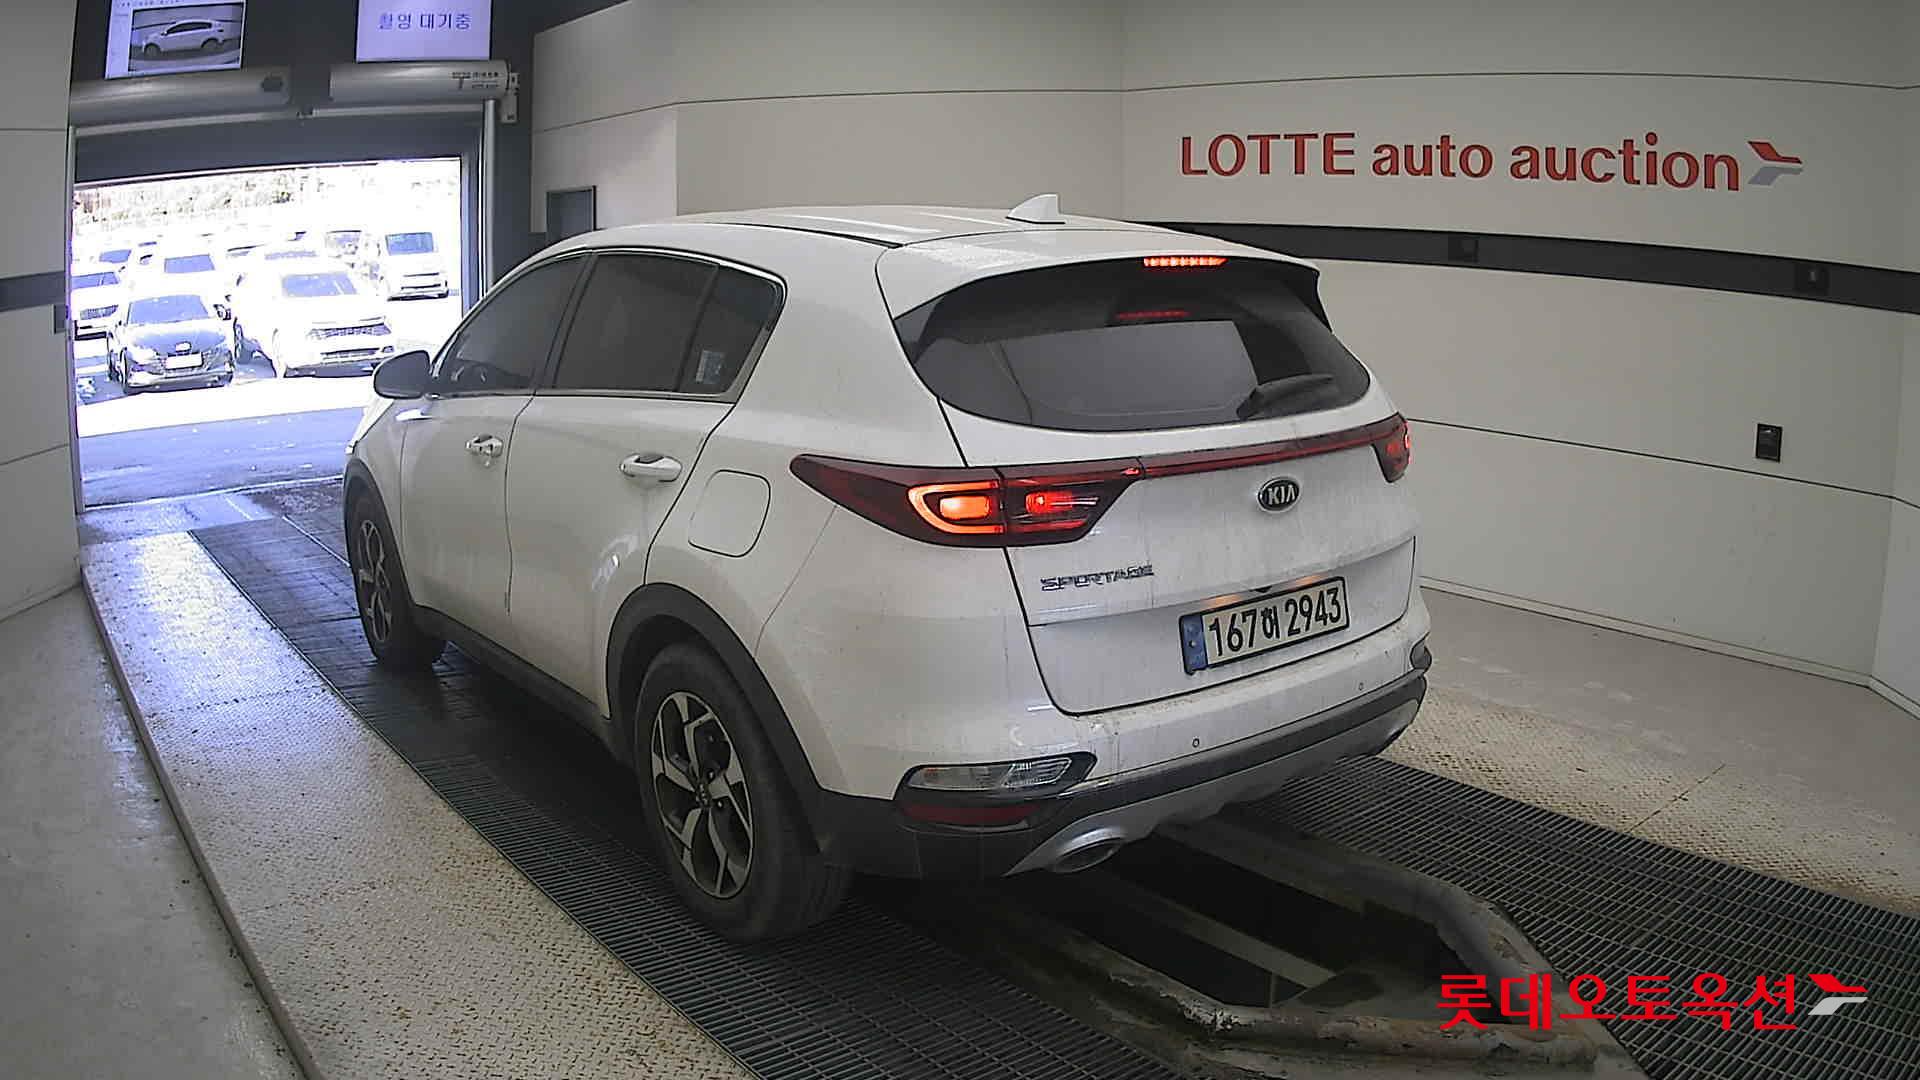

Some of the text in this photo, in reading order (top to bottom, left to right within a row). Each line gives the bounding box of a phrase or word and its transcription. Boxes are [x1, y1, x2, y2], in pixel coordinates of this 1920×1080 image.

[420, 12, 471, 30] 대기중
[1181, 132, 1739, 191] LOTTE auto auction
[1267, 484, 1296, 505] KIA
[1208, 587, 1341, 657] 167허 2943
